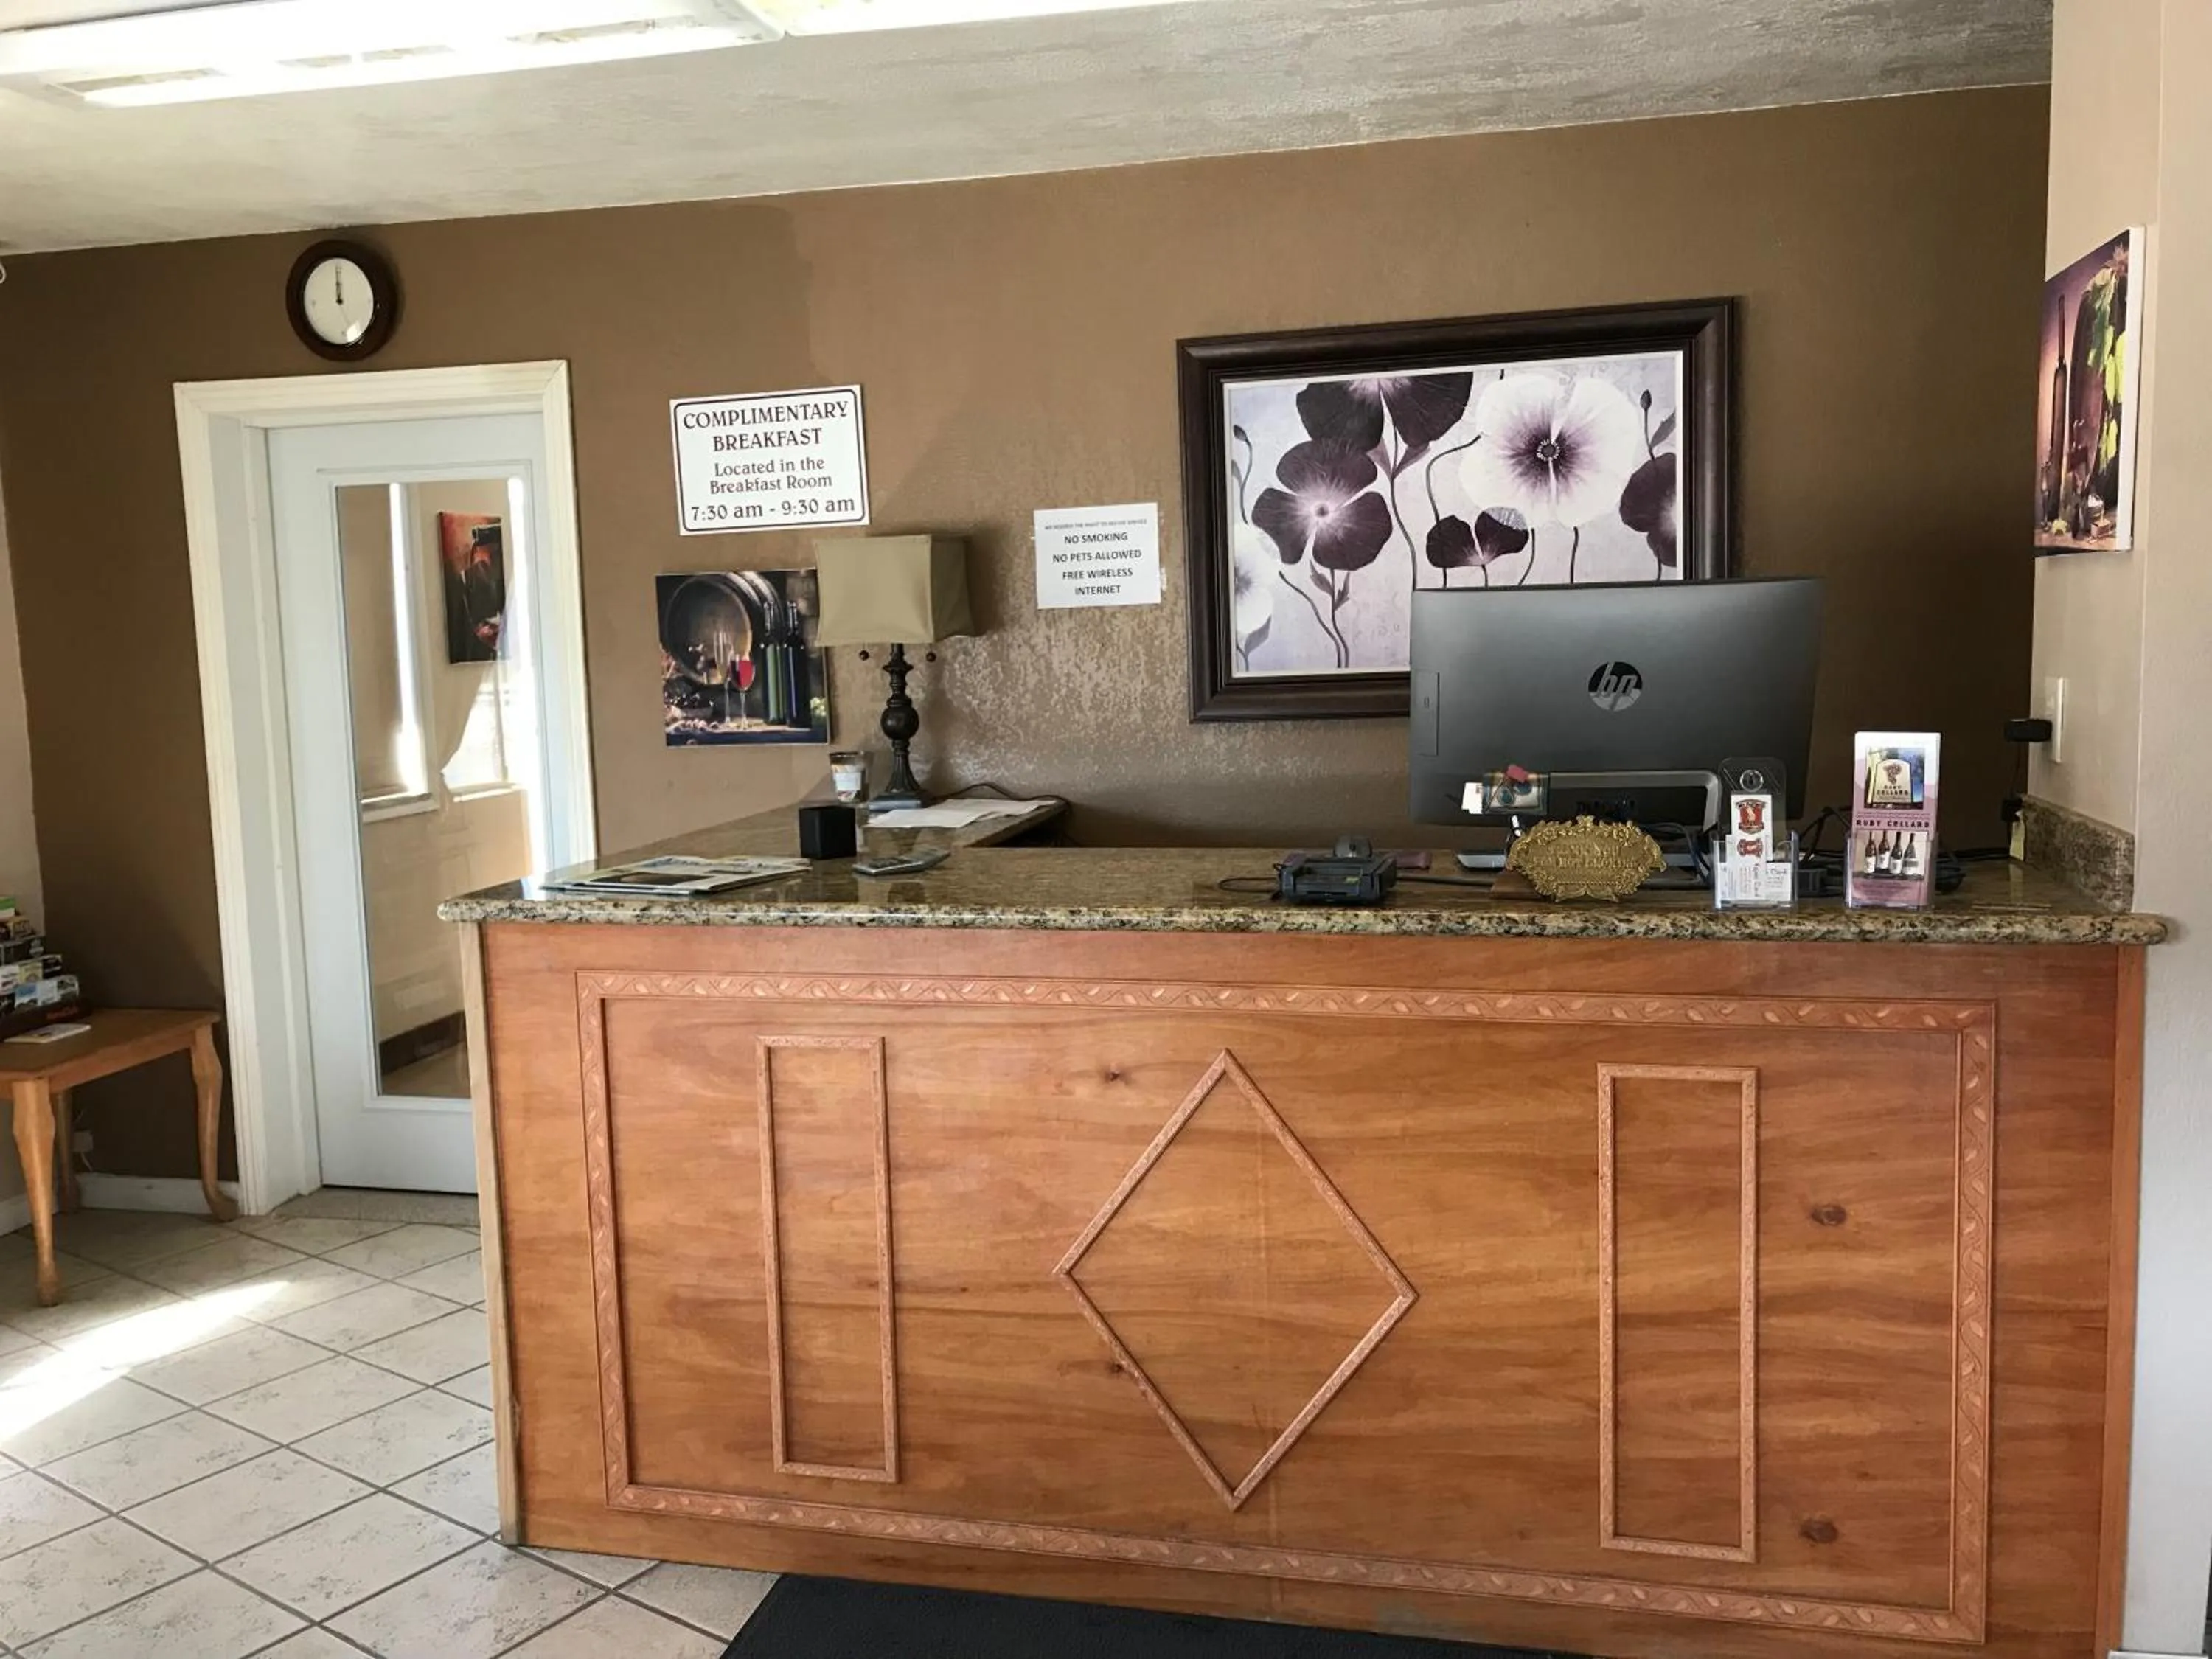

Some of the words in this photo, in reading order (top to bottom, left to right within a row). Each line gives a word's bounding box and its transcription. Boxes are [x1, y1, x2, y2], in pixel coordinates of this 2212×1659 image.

[683, 400, 849, 430] COMPLIMENTARY
[712, 427, 822, 452] BREAKFAST
[714, 459, 775, 477] Located
[780, 459, 796, 473] in
[800, 456, 825, 471] the
[710, 478, 782, 495] Breakfast
[786, 474, 832, 490] Room
[691, 504, 728, 521] 7:30
[734, 504, 763, 518] am
[781, 498, 819, 516] 9:30
[824, 498, 855, 512] am
[1064, 535, 1080, 545] NO
[1082, 532, 1128, 543] SMOKING
[1052, 554, 1068, 564] NO
[1070, 552, 1093, 563] PETS
[1095, 549, 1143, 560] ALLOWED
[1062, 570, 1085, 580] FREE
[1087, 567, 1133, 580] WIRELESS
[1074, 585, 1121, 596] INTERNET
[1592, 661, 1640, 711] hp
[1856, 819, 1882, 827] RUBY
